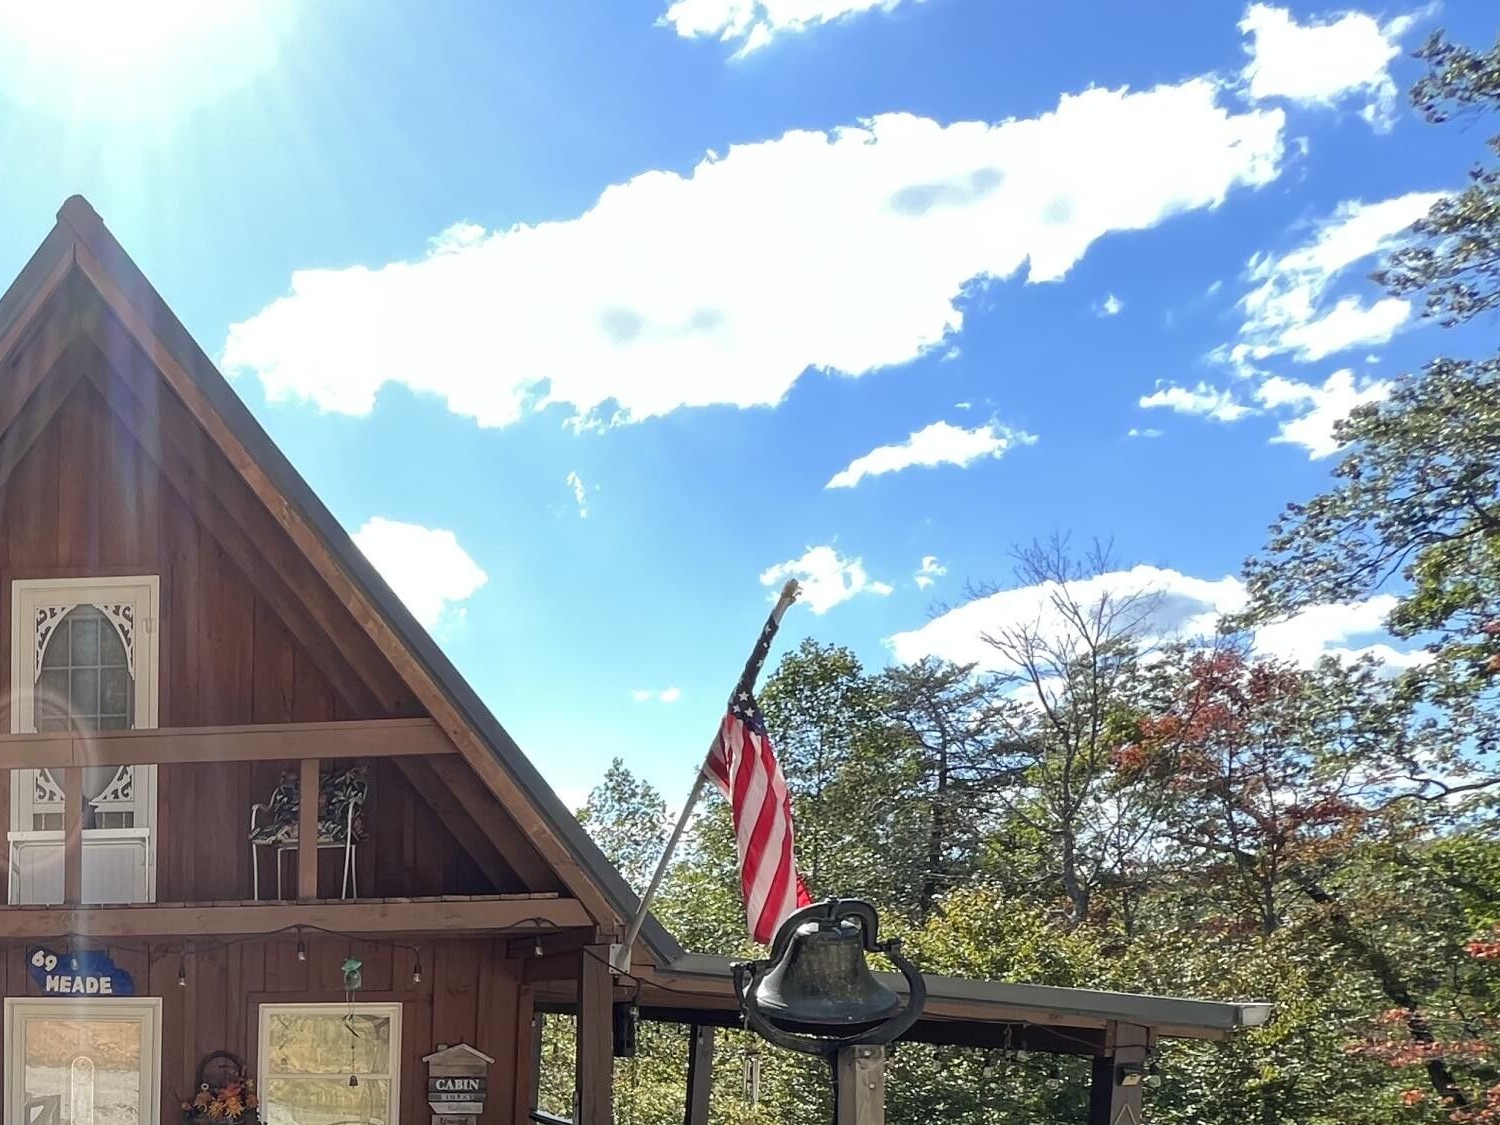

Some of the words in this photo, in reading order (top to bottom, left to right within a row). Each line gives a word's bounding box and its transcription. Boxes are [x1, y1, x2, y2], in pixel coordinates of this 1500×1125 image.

[31, 950, 58, 972] 69
[46, 975, 112, 994] MEADE
[435, 1079, 480, 1091] CABIN
